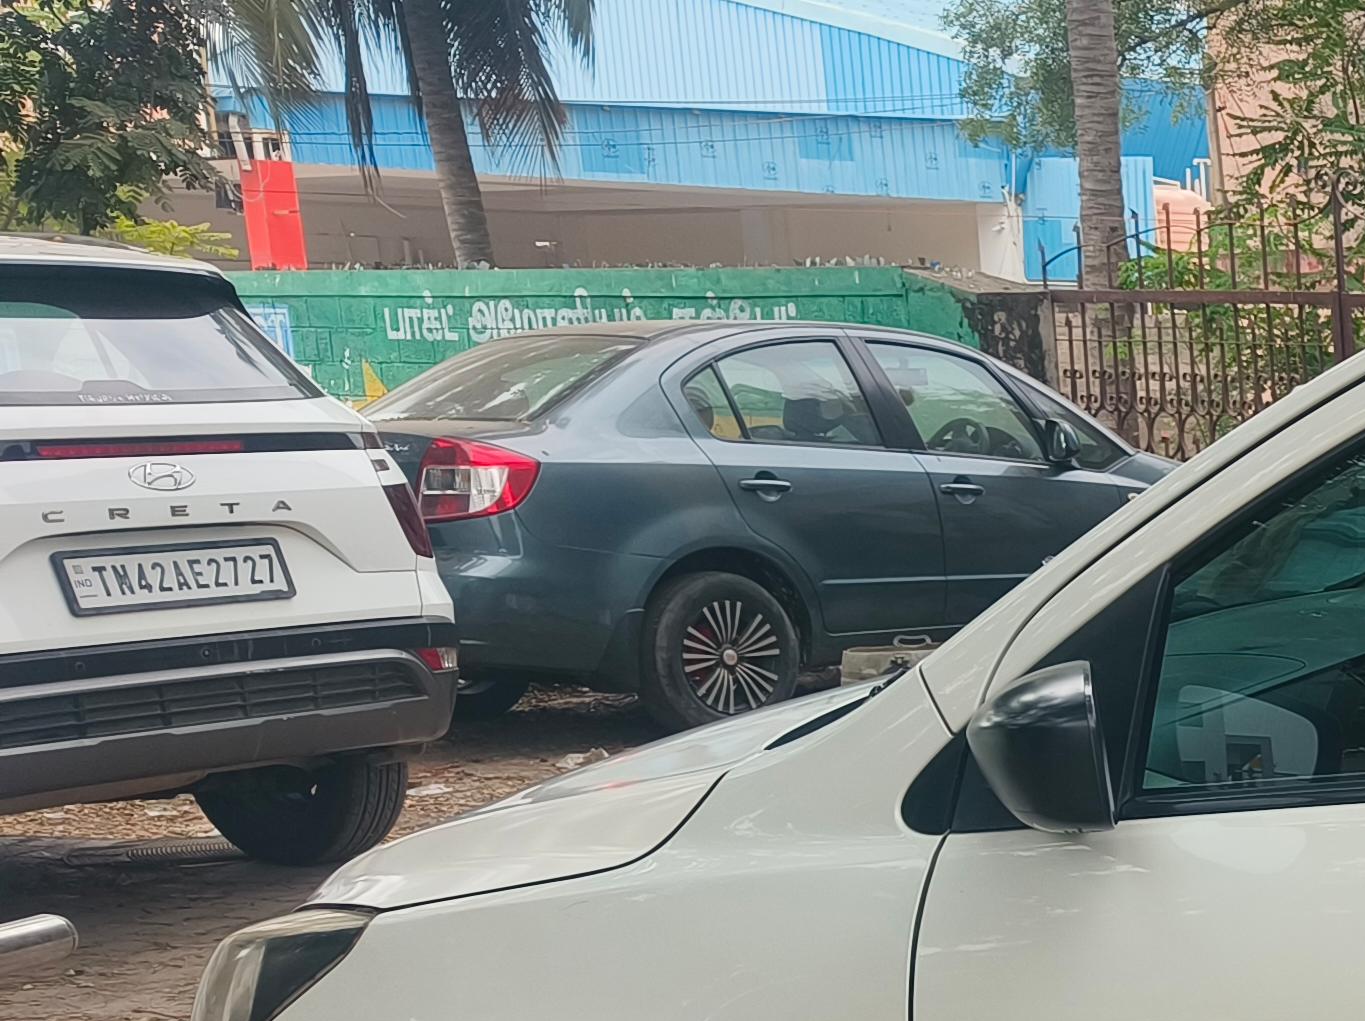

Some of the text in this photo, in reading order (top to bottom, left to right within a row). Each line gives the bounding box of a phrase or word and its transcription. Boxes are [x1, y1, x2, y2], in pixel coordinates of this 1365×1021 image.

[41, 499, 292, 524] CRETA
[74, 579, 93, 589] IND
[91, 553, 275, 598] TN42AE2727
